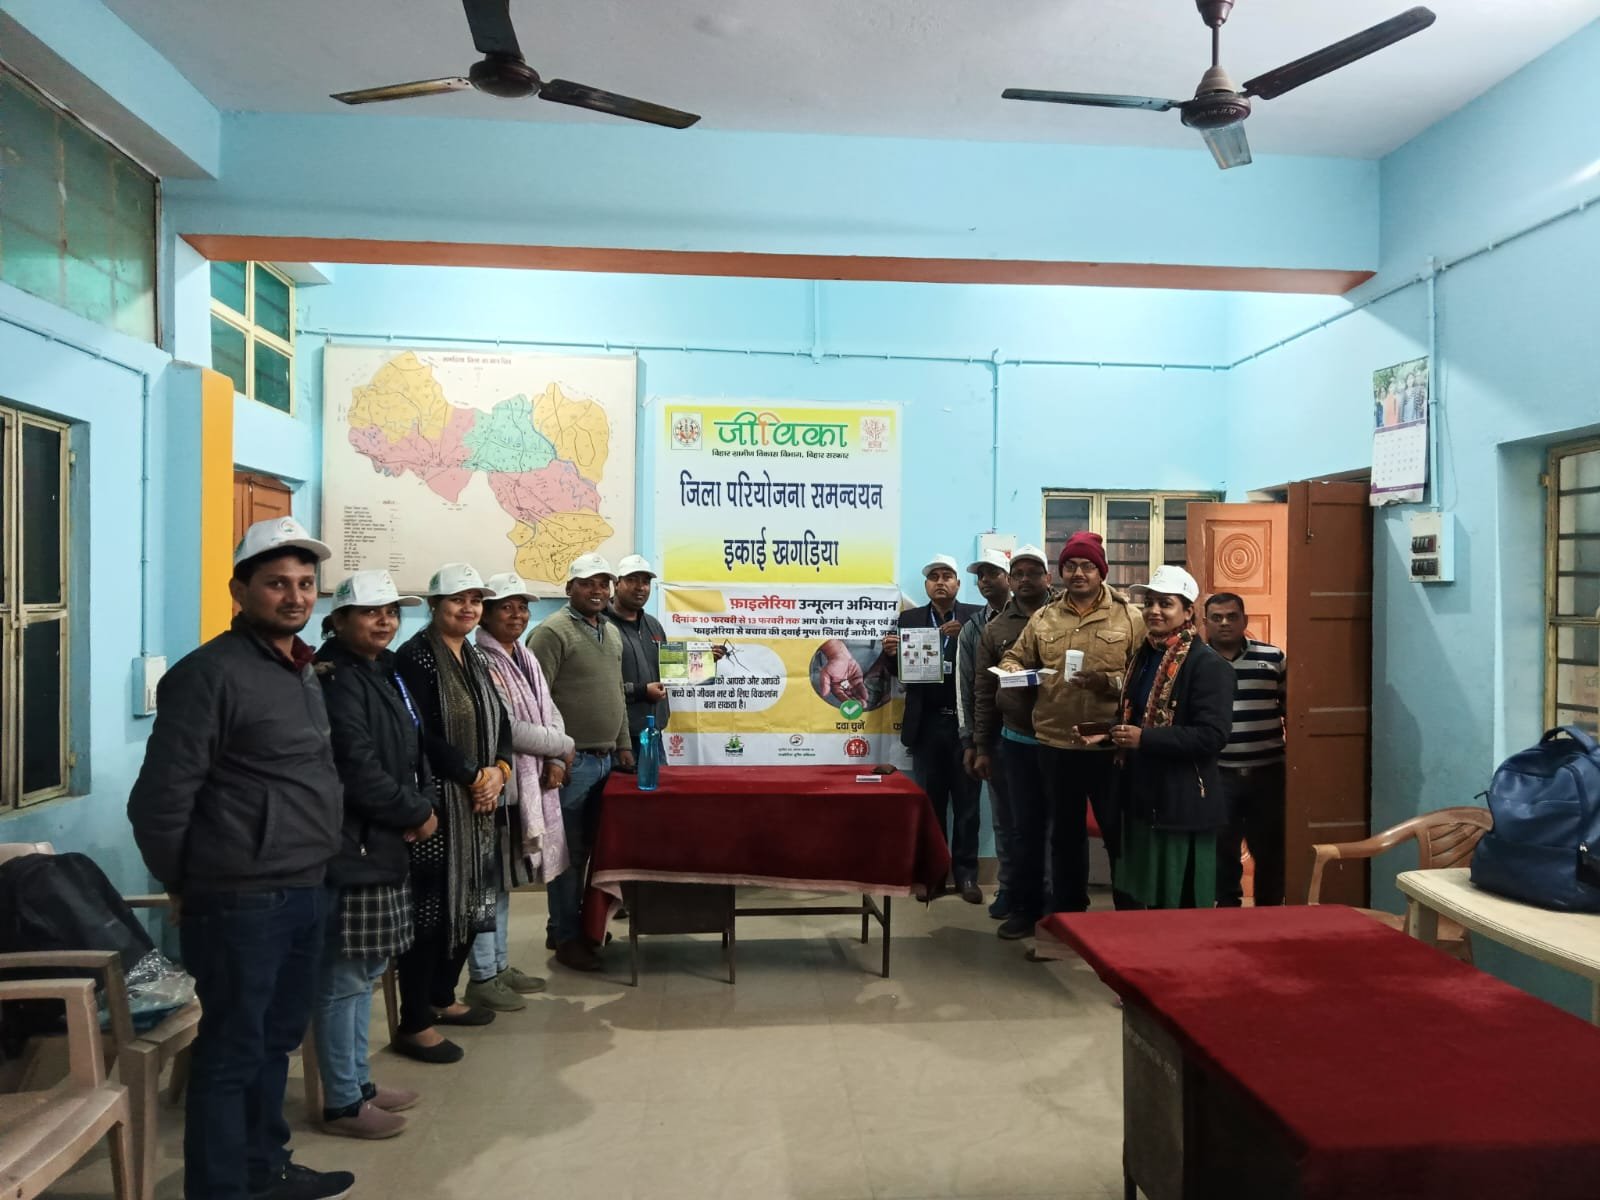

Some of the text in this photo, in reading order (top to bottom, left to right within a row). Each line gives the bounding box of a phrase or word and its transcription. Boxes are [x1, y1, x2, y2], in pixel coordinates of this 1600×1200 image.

[714, 412, 848, 447] जीविका
[680, 470, 883, 509] जिला परियोजना समन्वयन
[724, 527, 839, 572] इकाई खगड़िया
[799, 599, 844, 614] उन्मूलन
[847, 596, 898, 611] अभियान
[672, 614, 698, 624] दिनांक
[700, 616, 709, 624] 10
[711, 615, 736, 624] फरवरी
[738, 614, 746, 624] से
[758, 615, 784, 625] फरवरी
[785, 617, 800, 625] तक
[802, 617, 818, 625] आप
[820, 616, 828, 625] के
[846, 616, 854, 625] के
[856, 618, 876, 628] स्कूल
[693, 626, 735, 636] फाइलेरिया
[736, 626, 744, 635] से
[745, 627, 767, 635] बचाव
[768, 626, 780, 635] की
[781, 627, 801, 636] दवाई
[747, 675, 760, 685] और
[686, 688, 696, 698] को
[728, 688, 736, 698] के
